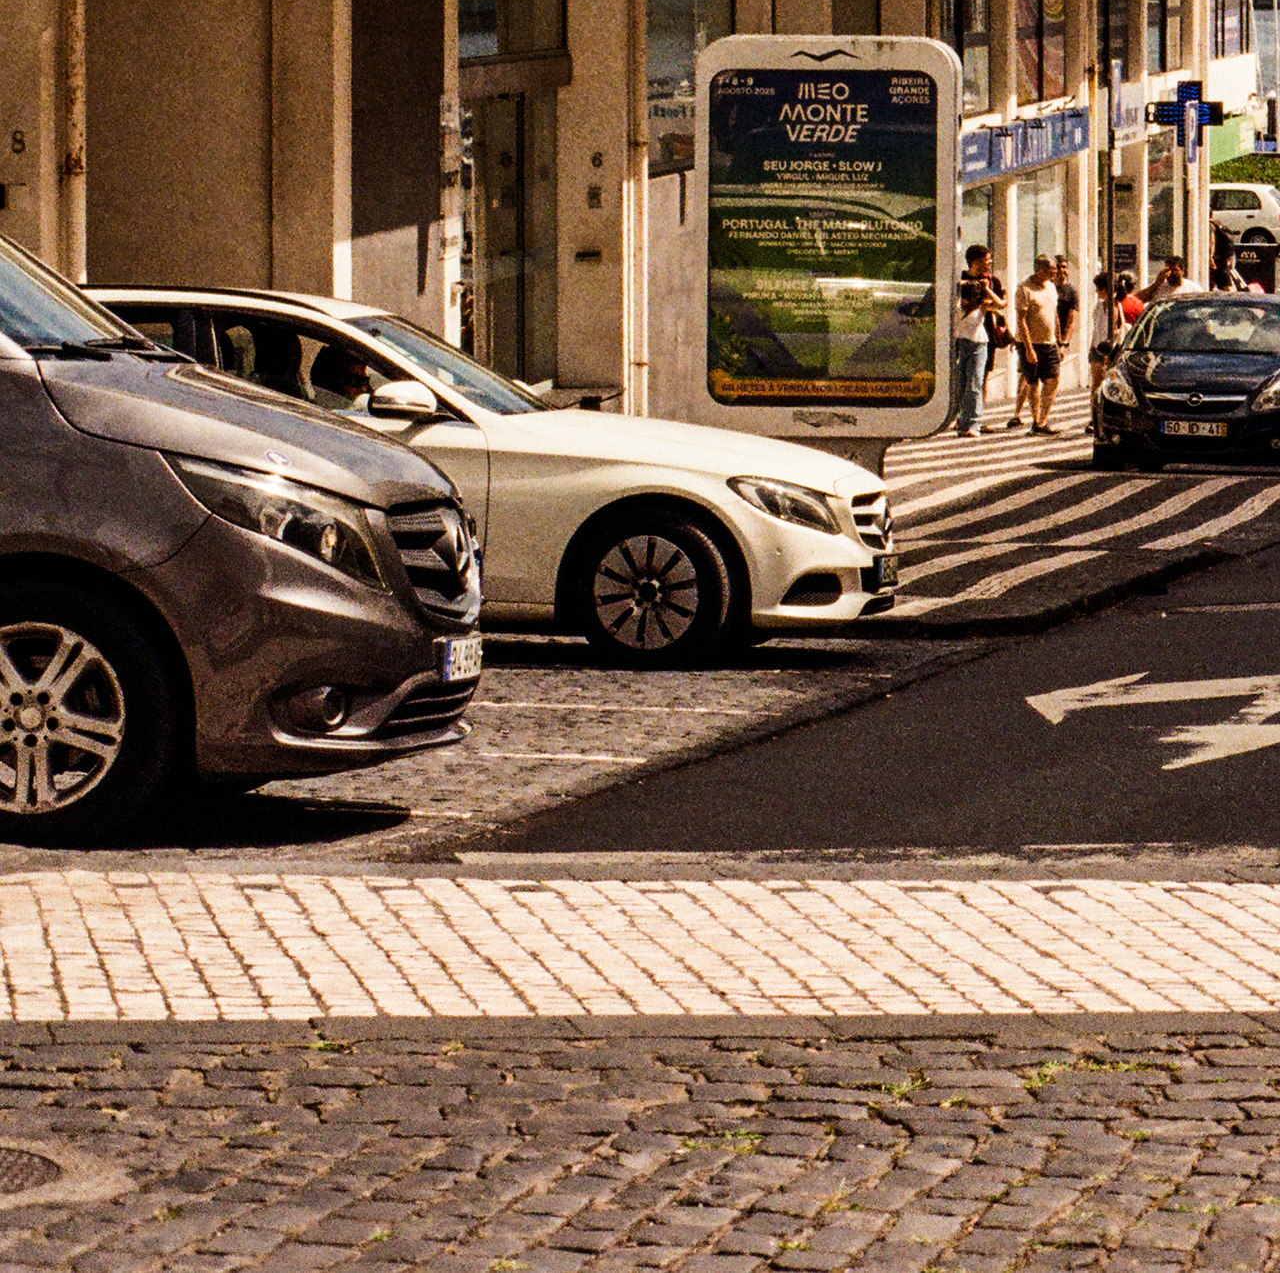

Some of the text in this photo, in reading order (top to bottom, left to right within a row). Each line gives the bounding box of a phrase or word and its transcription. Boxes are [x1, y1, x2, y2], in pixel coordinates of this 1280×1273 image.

[747, 77, 754, 86] 9
[891, 77, 930, 86] RIBEIRA
[718, 87, 752, 95] AGOSTO
[889, 86, 930, 95] GRANDE
[891, 96, 930, 105] AÇORES
[778, 104, 869, 122] MONTE
[785, 124, 862, 143] VERDE
[591, 152, 603, 167] 6
[763, 160, 787, 171] SEU
[789, 160, 830, 171] JORGE
[838, 161, 875, 172] SLOW
[797, 219, 820, 230] THE
[728, 231, 778, 239] FERNANDO
